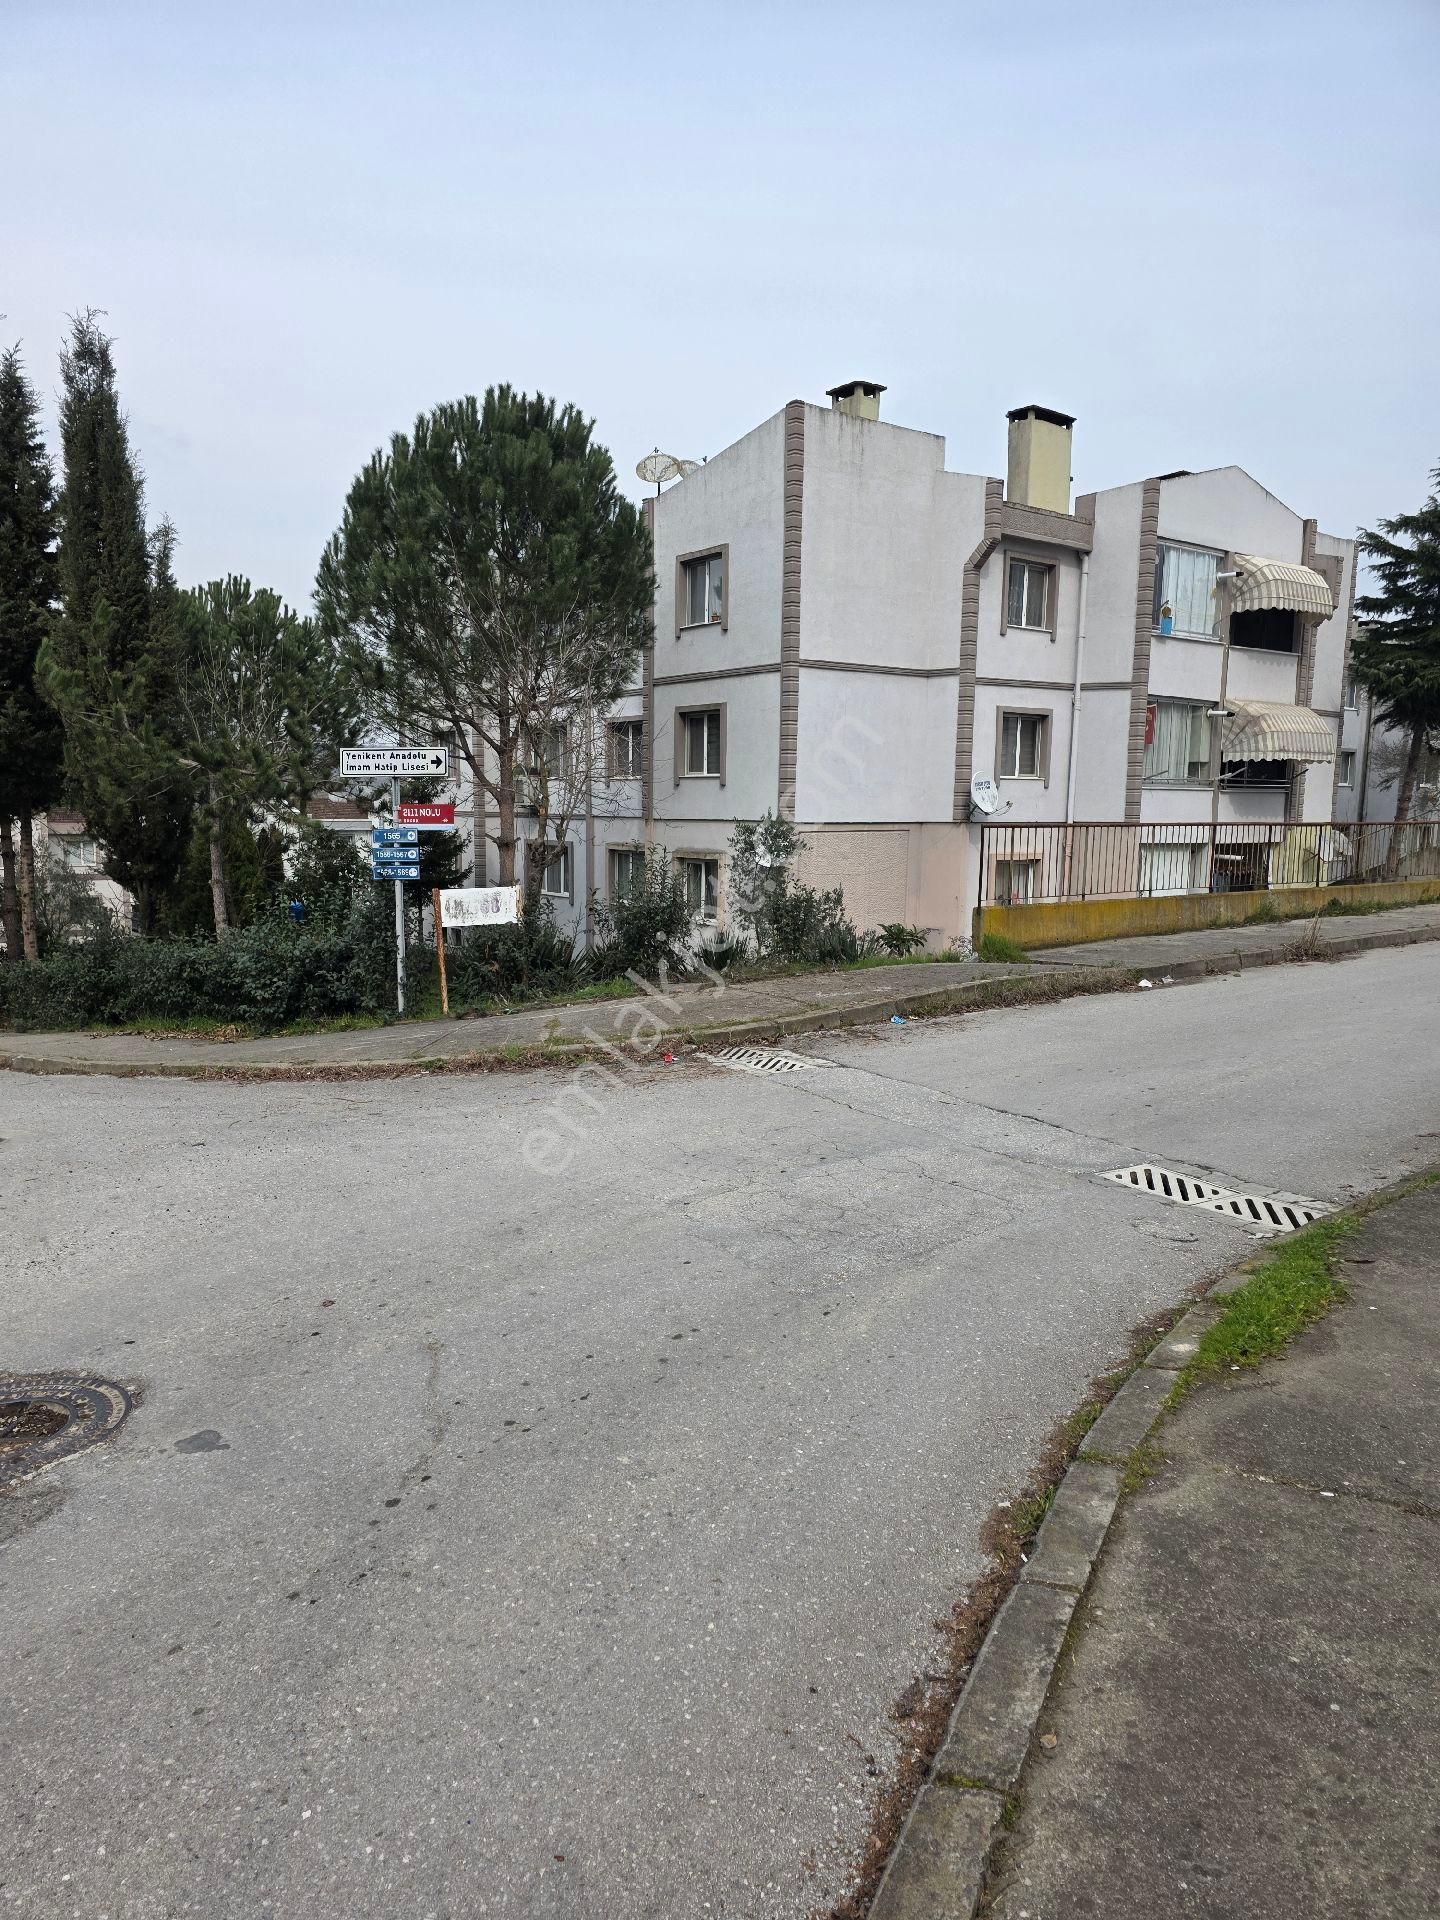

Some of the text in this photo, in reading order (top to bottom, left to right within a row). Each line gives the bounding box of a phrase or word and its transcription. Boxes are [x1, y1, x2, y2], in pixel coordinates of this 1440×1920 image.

[346, 752, 427, 760] Yenikent Anadolu
[346, 761, 429, 773] İmam Hatip Lisesi
